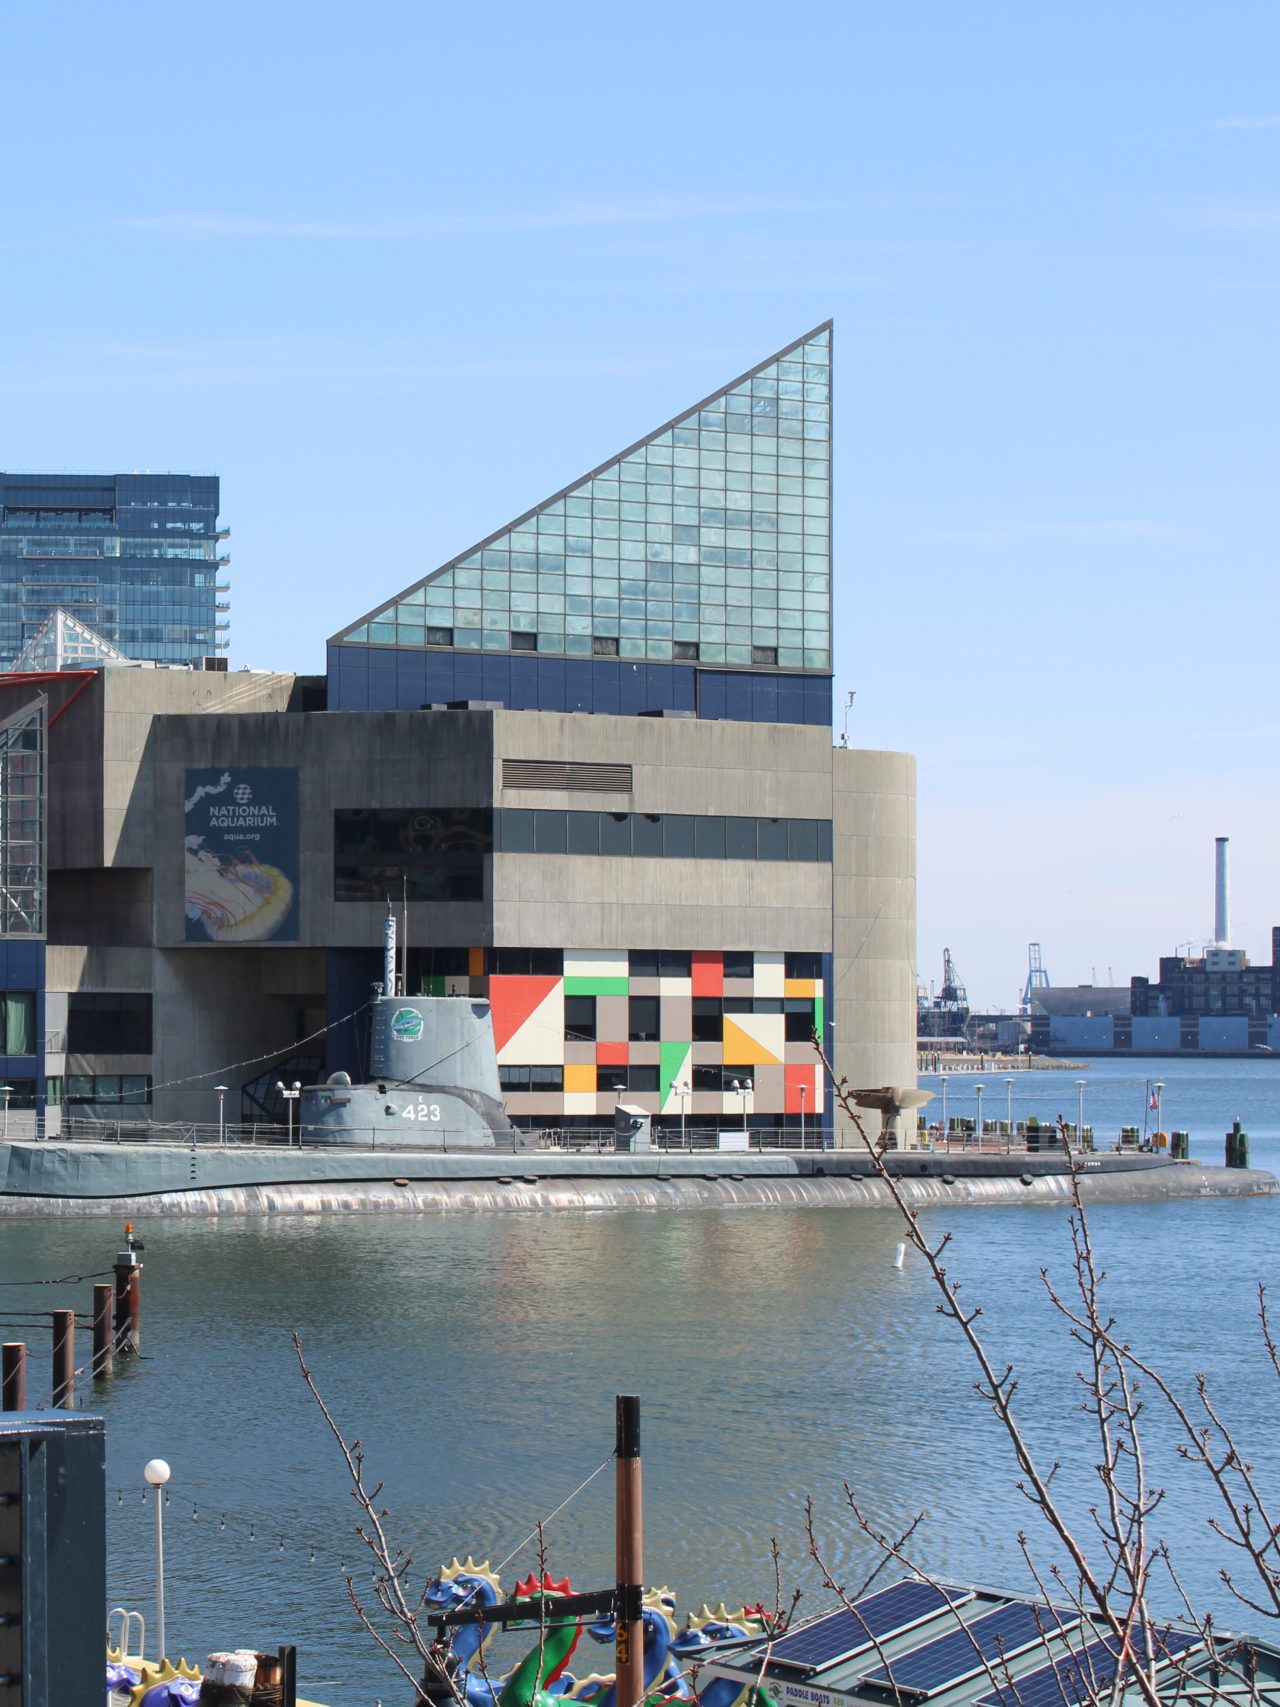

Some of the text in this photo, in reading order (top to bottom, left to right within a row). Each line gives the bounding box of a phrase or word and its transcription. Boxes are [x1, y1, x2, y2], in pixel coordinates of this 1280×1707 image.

[209, 805, 277, 817] NATIONAL
[209, 816, 277, 827] AQUARIUM
[223, 833, 260, 841] aqua.org
[402, 1104, 441, 1121] 423
[786, 1686, 809, 1700] PADDLE
[810, 1691, 830, 1705] BOATS
